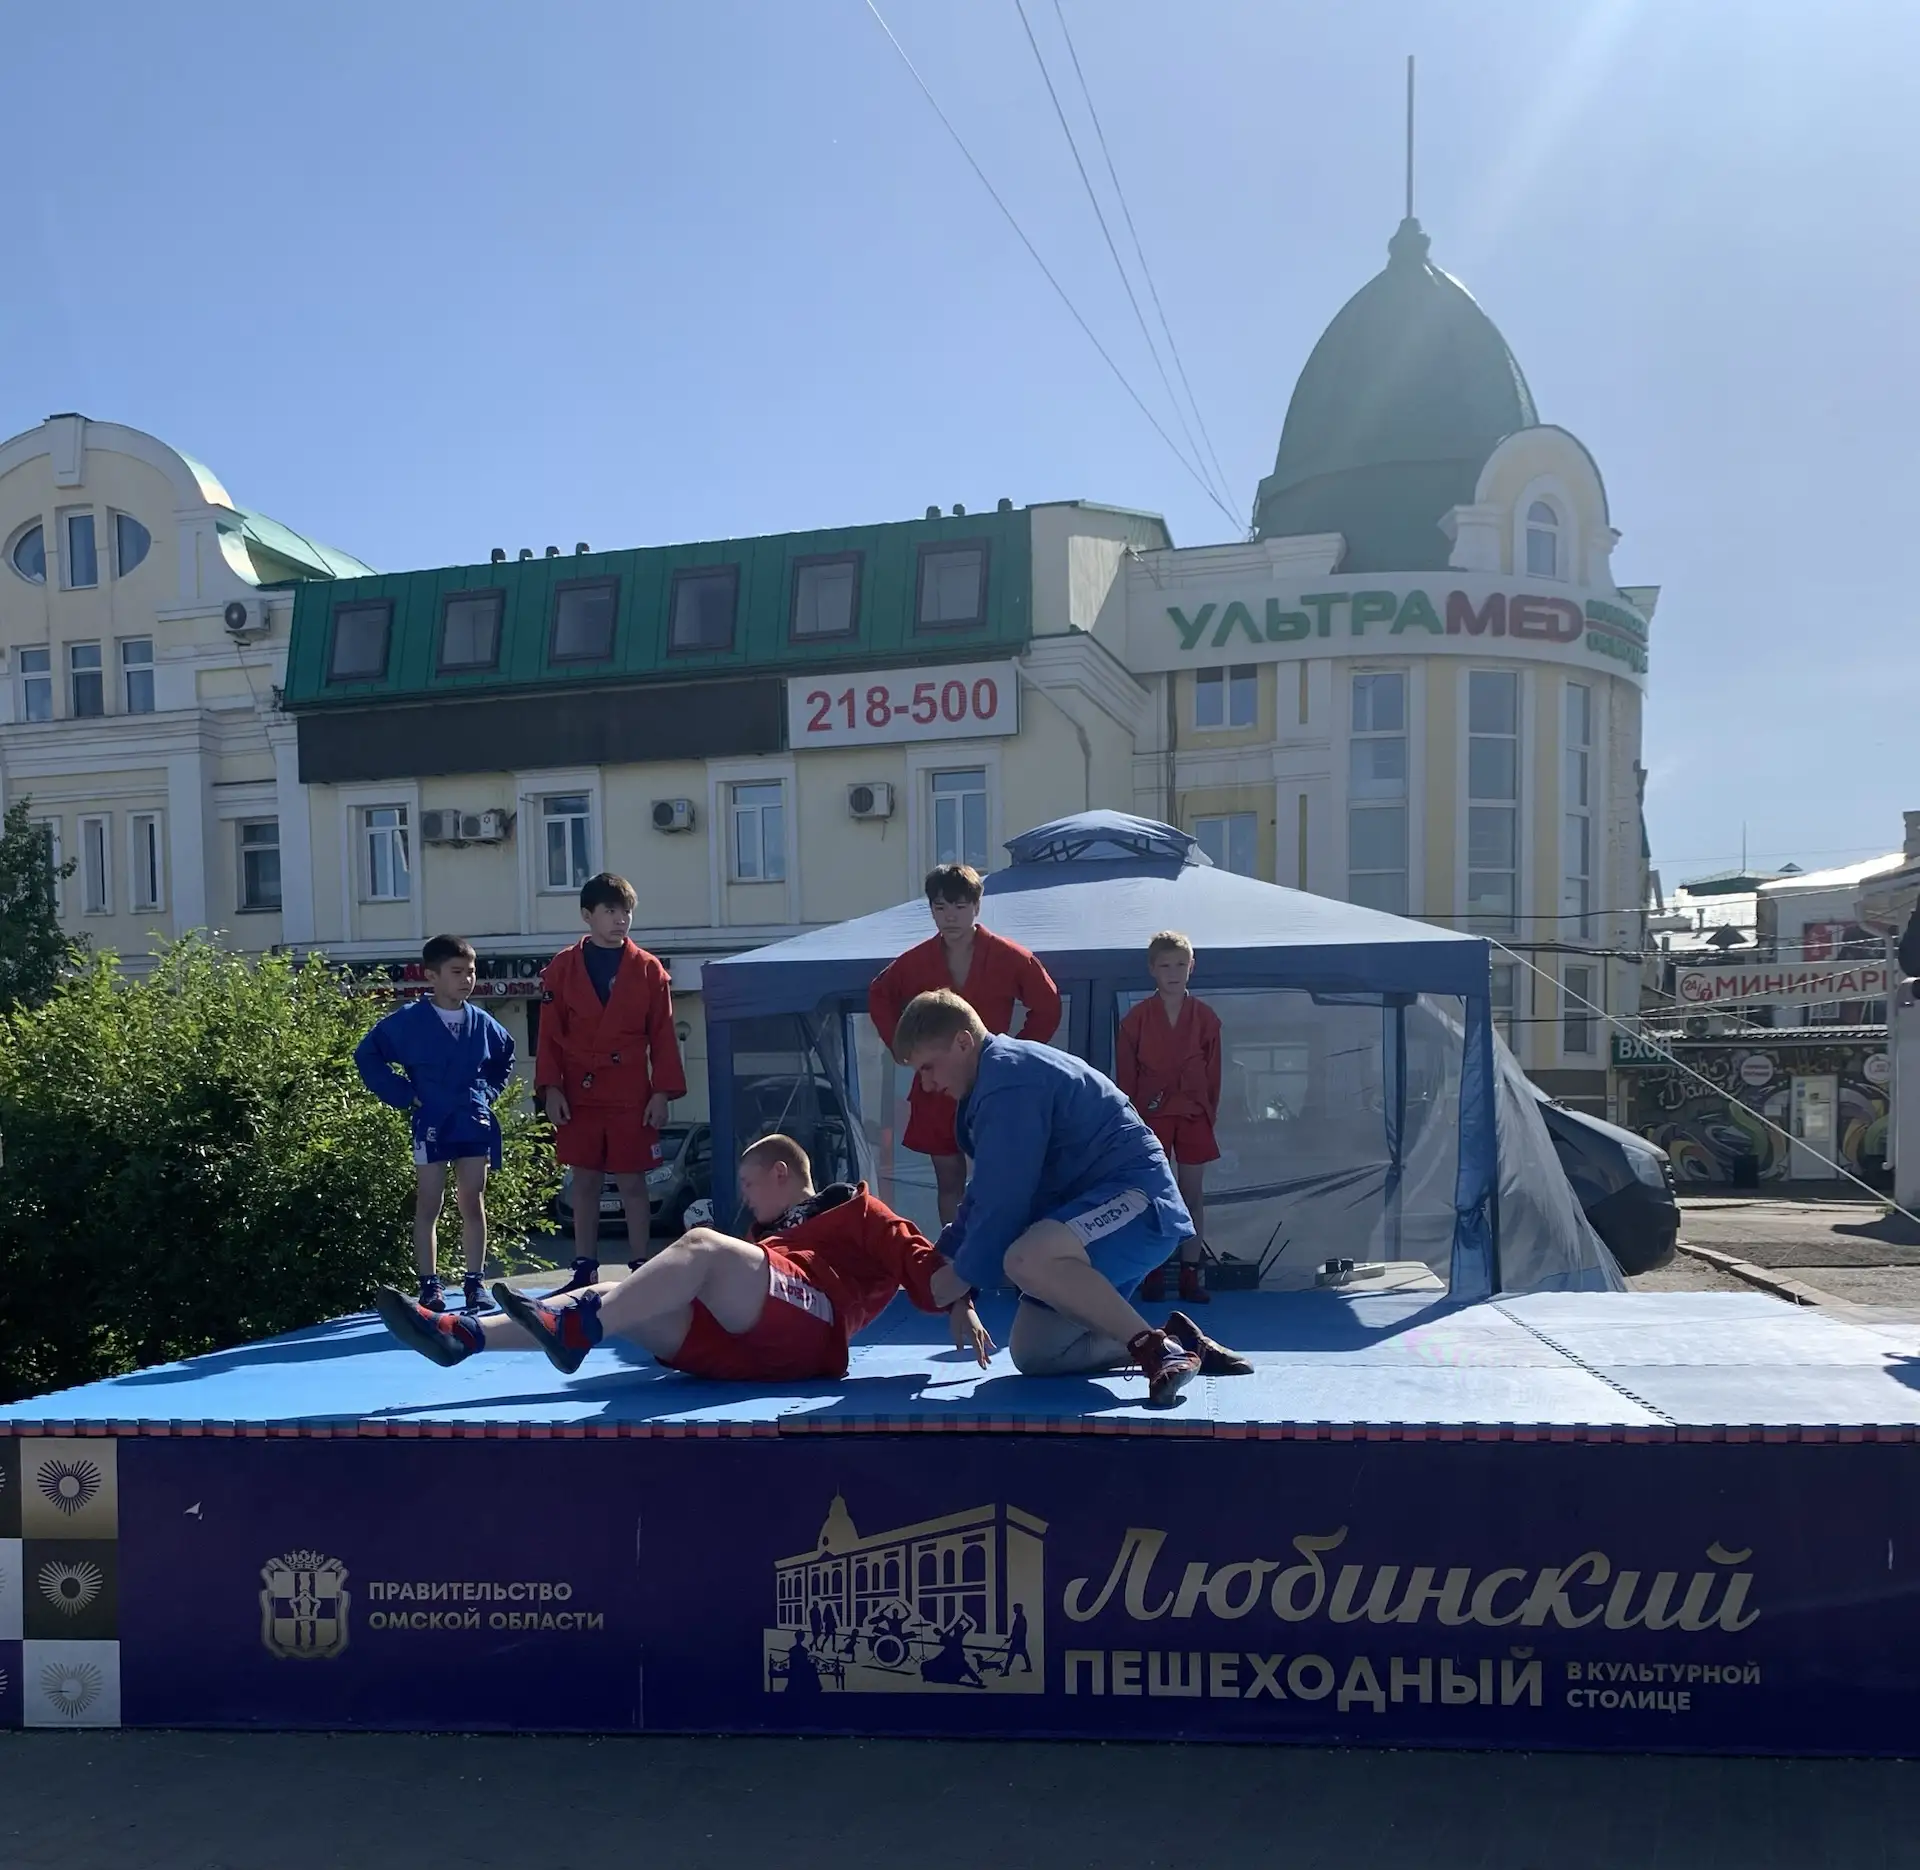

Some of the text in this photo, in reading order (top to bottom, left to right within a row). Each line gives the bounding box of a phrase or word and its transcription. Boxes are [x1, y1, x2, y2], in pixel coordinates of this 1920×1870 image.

[806, 677, 998, 732] 218-500
[1619, 1036, 1672, 1062] ВХОД
[1063, 1524, 1761, 1633] Любинский
[368, 1582, 573, 1601] ПРАВИТЕЛЬСТВО
[368, 1607, 605, 1631] ОМСКОЙ ОБЛАСТИ
[1064, 1646, 1543, 1713] ПЕШЕХОДНЫЙ
[1567, 1660, 1761, 1685] В КУЛЬТУРНОЙ
[1566, 1689, 1691, 1714] СТОЛИЦЕ
